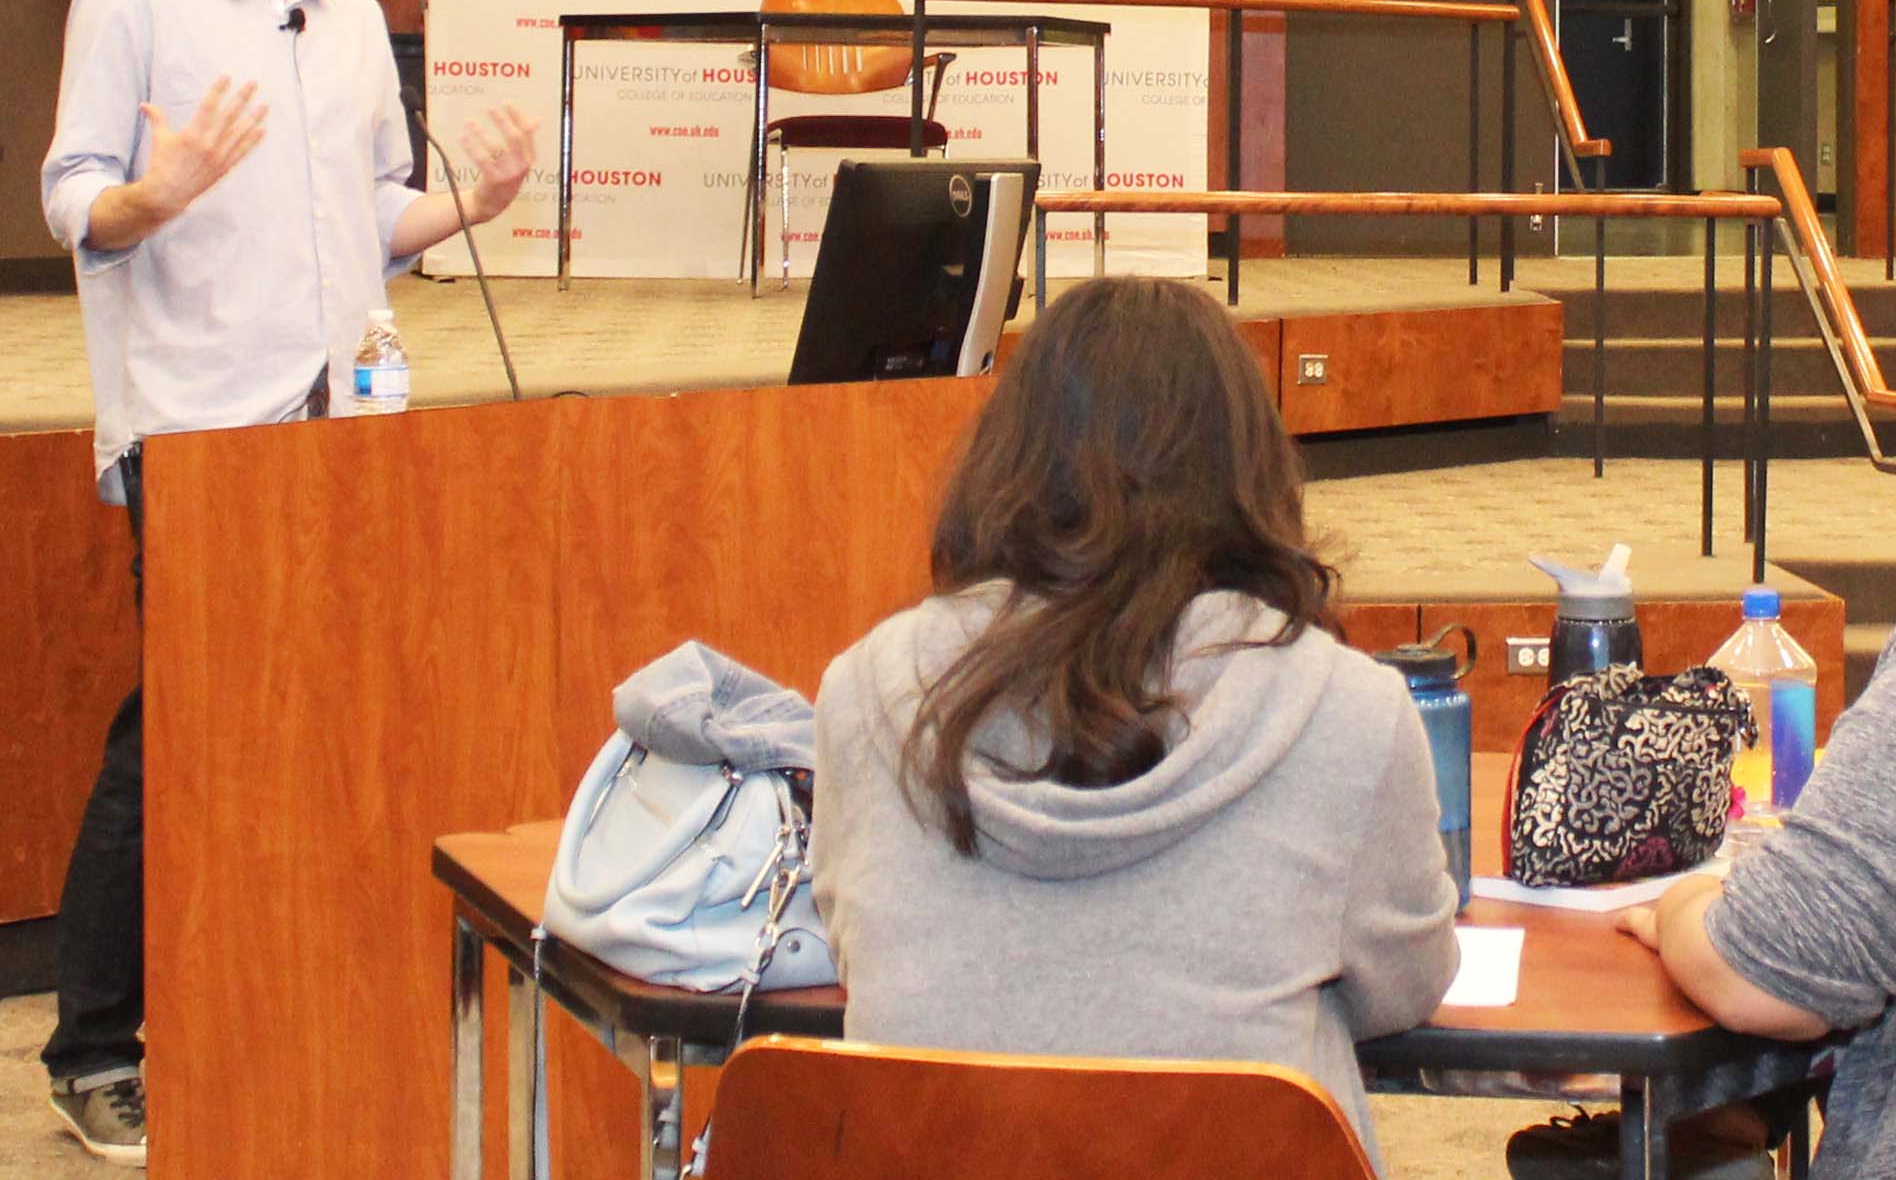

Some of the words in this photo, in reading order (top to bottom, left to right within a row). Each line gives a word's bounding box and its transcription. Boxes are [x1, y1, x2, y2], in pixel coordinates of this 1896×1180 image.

[434, 61, 530, 78] HOUSTON
[702, 68, 756, 84] HOUS
[1107, 173, 1185, 188] OUSTON
